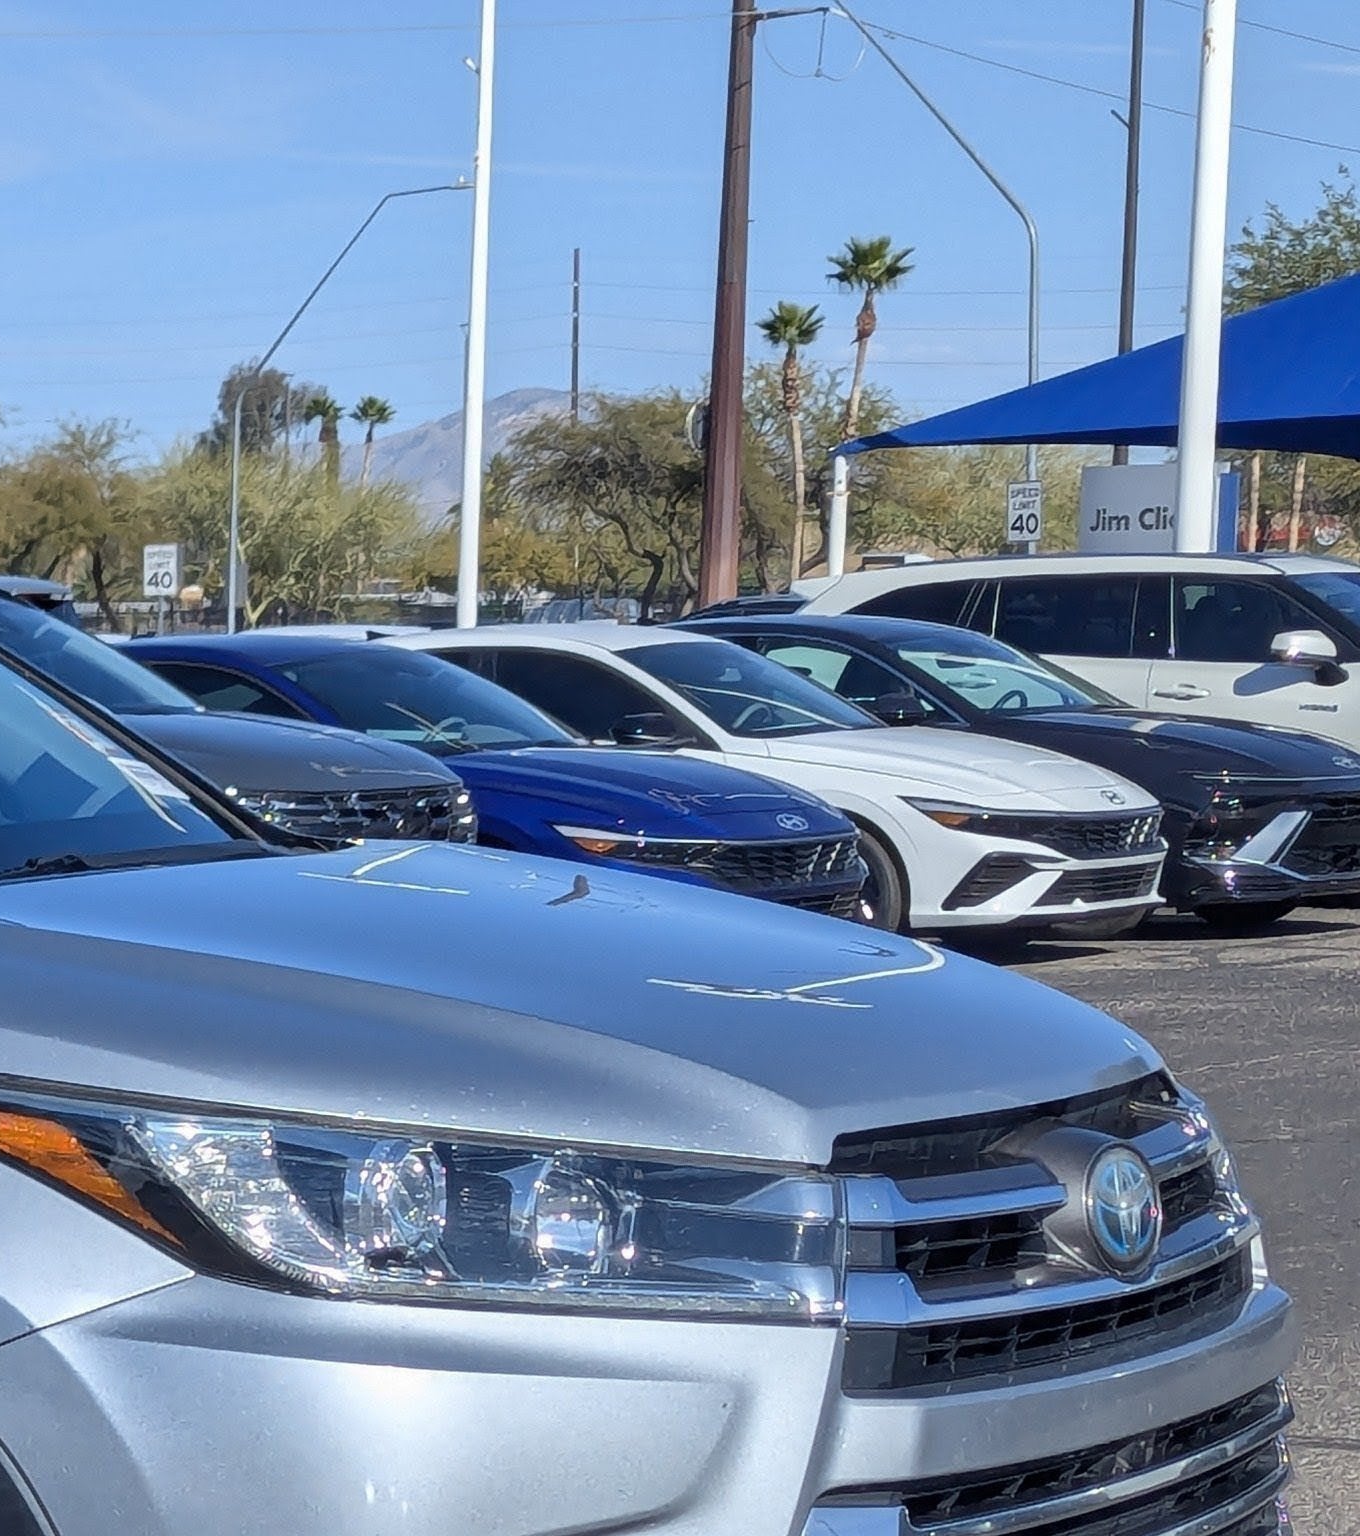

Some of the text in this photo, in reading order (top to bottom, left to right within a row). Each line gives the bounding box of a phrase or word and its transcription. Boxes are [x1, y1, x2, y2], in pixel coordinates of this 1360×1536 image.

[1010, 513, 1039, 535] 40
[1089, 508, 1130, 532] Jim
[147, 571, 173, 589] 40
